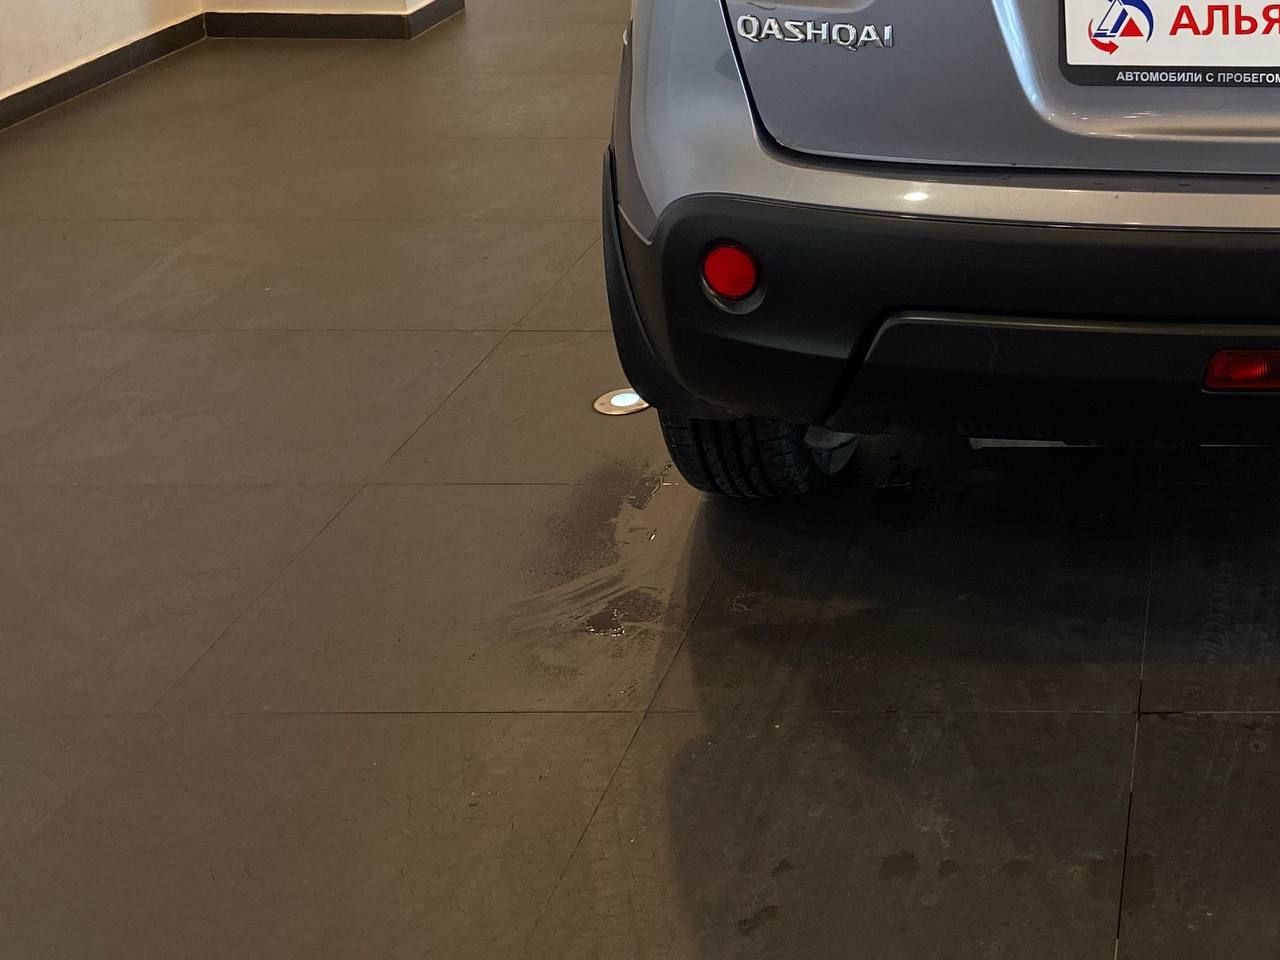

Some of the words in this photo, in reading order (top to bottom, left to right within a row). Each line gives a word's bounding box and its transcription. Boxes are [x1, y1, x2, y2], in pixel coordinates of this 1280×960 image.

[737, 14, 894, 51] QASHQAI
[1116, 71, 1202, 82] АВТОМОБИЛИ
[1206, 72, 1214, 82] С
